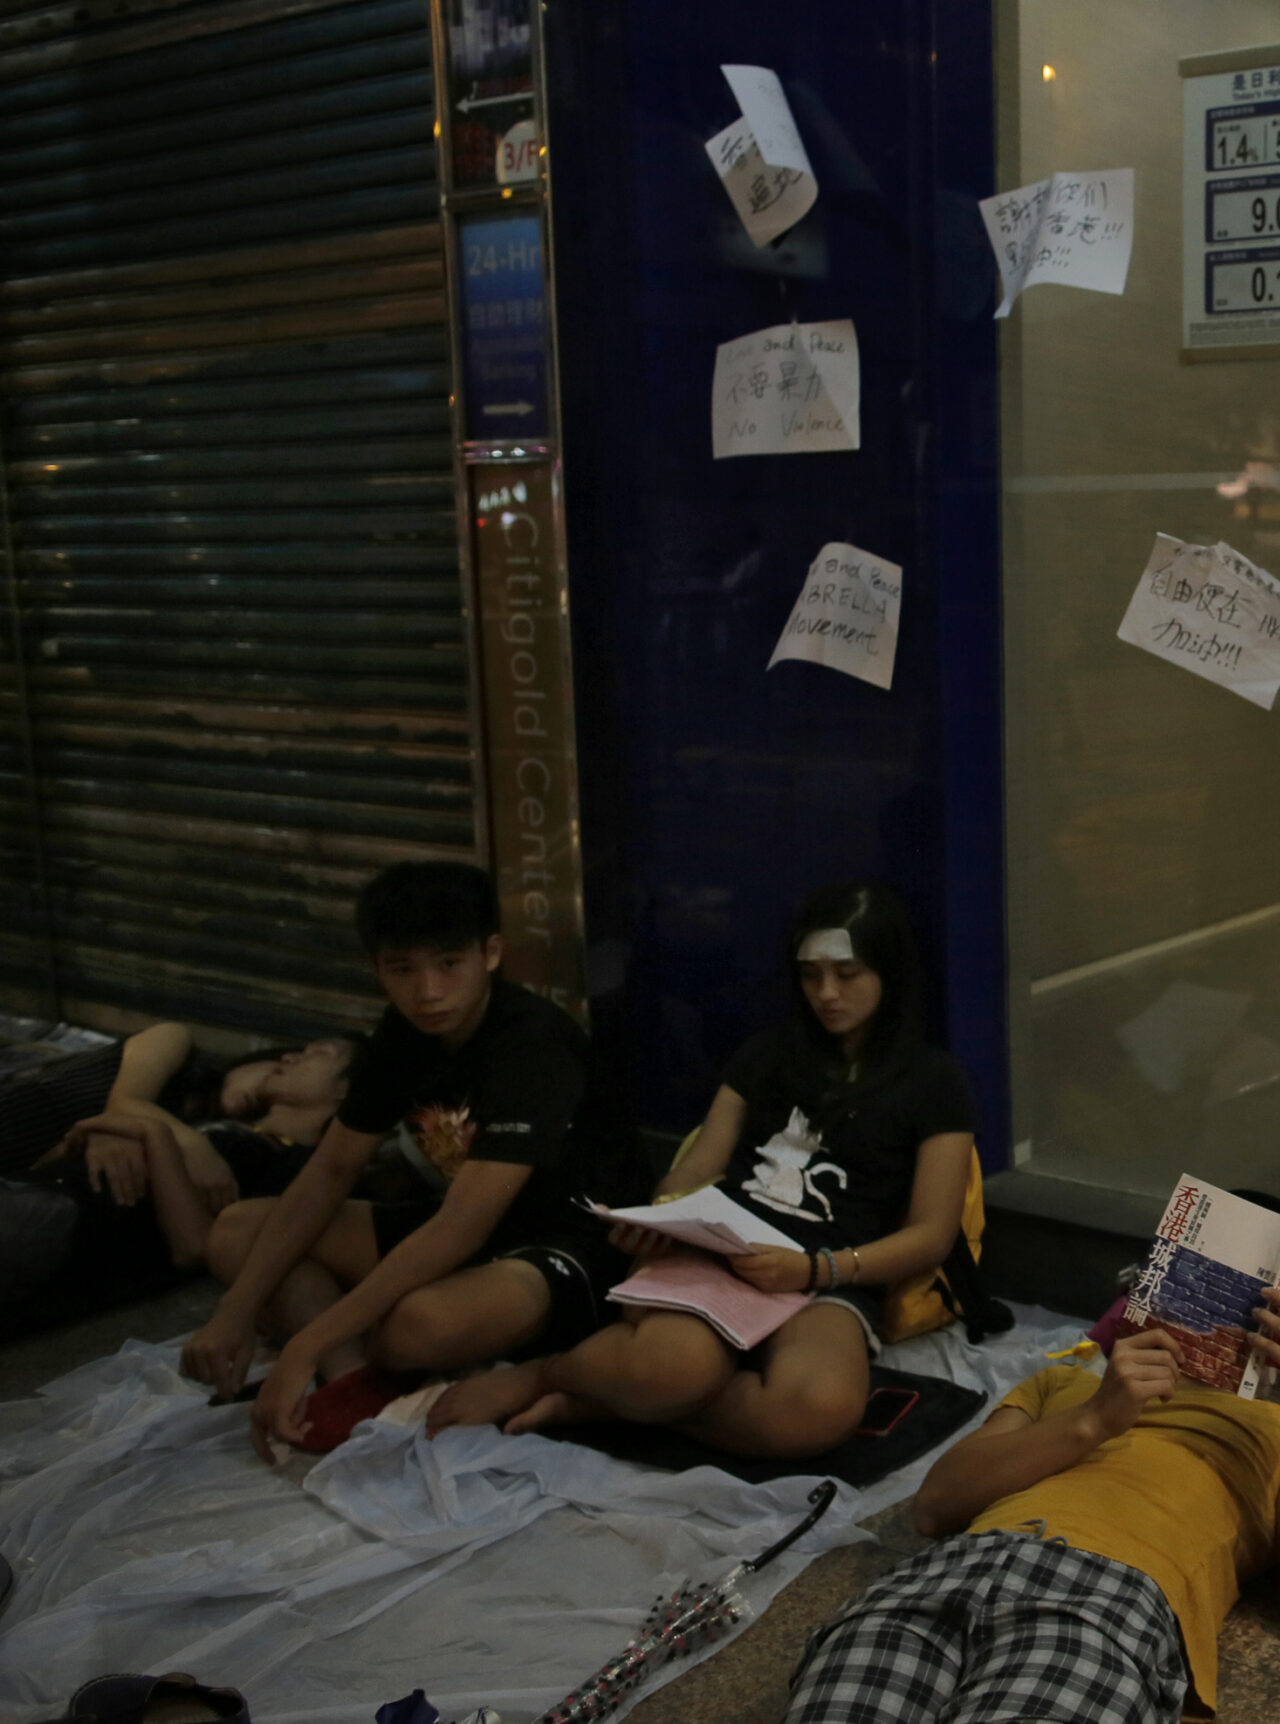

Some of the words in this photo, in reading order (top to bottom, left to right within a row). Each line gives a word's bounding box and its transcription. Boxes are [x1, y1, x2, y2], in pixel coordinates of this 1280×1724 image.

[468, 240, 539, 276] 24-Hr
[728, 418, 758, 439] No
[501, 511, 547, 739] Citigold
[516, 757, 556, 948] Center
[1122, 1184, 1199, 1327] 香港城邦論
